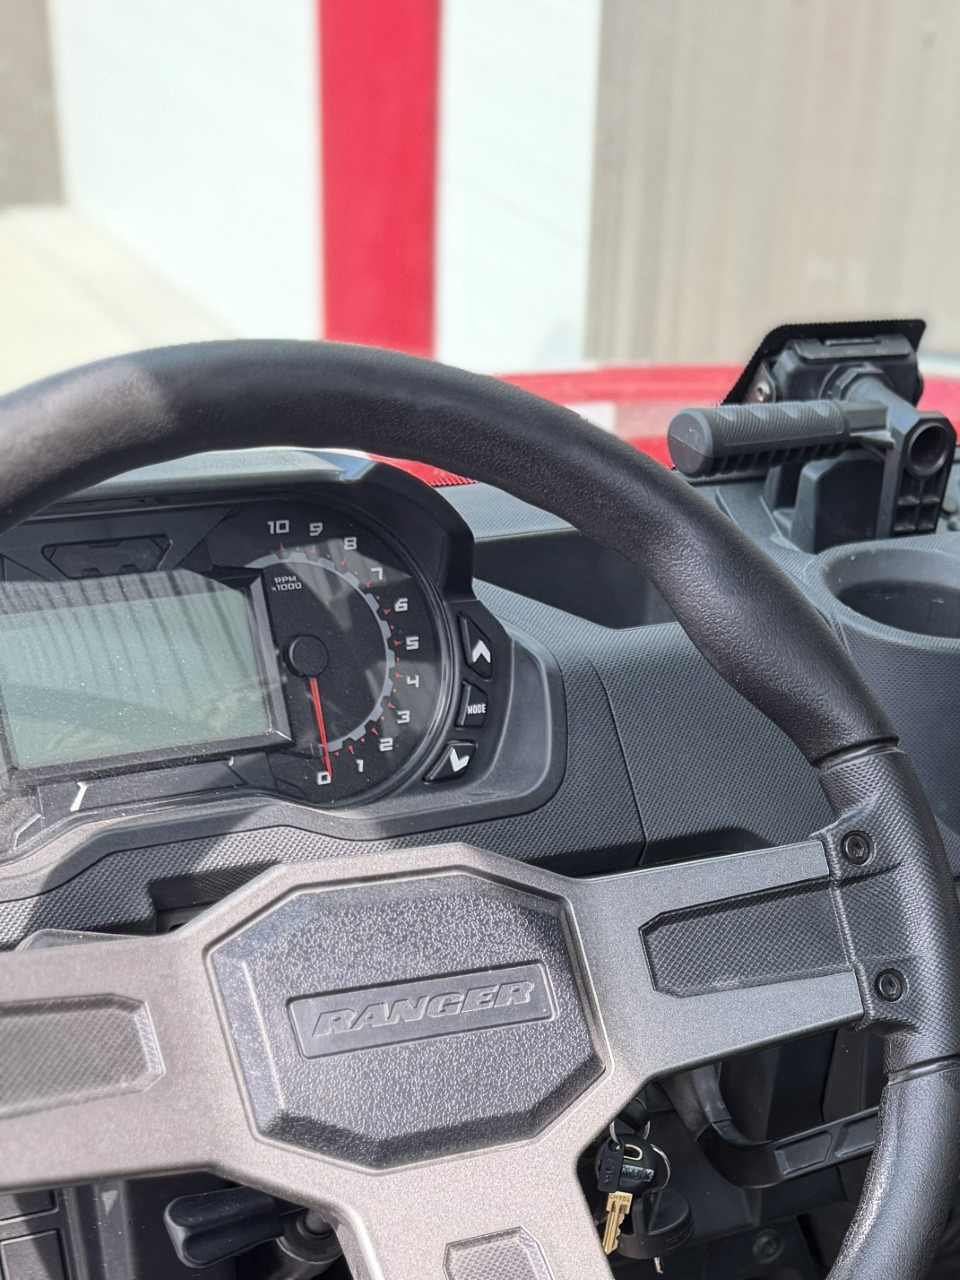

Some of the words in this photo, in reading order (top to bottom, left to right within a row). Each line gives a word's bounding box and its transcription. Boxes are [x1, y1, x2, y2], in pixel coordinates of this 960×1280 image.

[267, 520, 290, 535] 10
[309, 522, 323, 537] 9
[343, 536, 358, 550] 8
[274, 575, 298, 585] RPM
[370, 566, 384, 581] 7
[394, 598, 409, 612] 6
[405, 636, 420, 650] 5
[406, 674, 420, 688] 4
[397, 709, 411, 724] 3
[467, 703, 487, 715] MODE
[379, 737, 394, 752] 2
[355, 758, 364, 773] 1
[316, 771, 332, 786] 0
[311, 980, 535, 1038] RANGER
